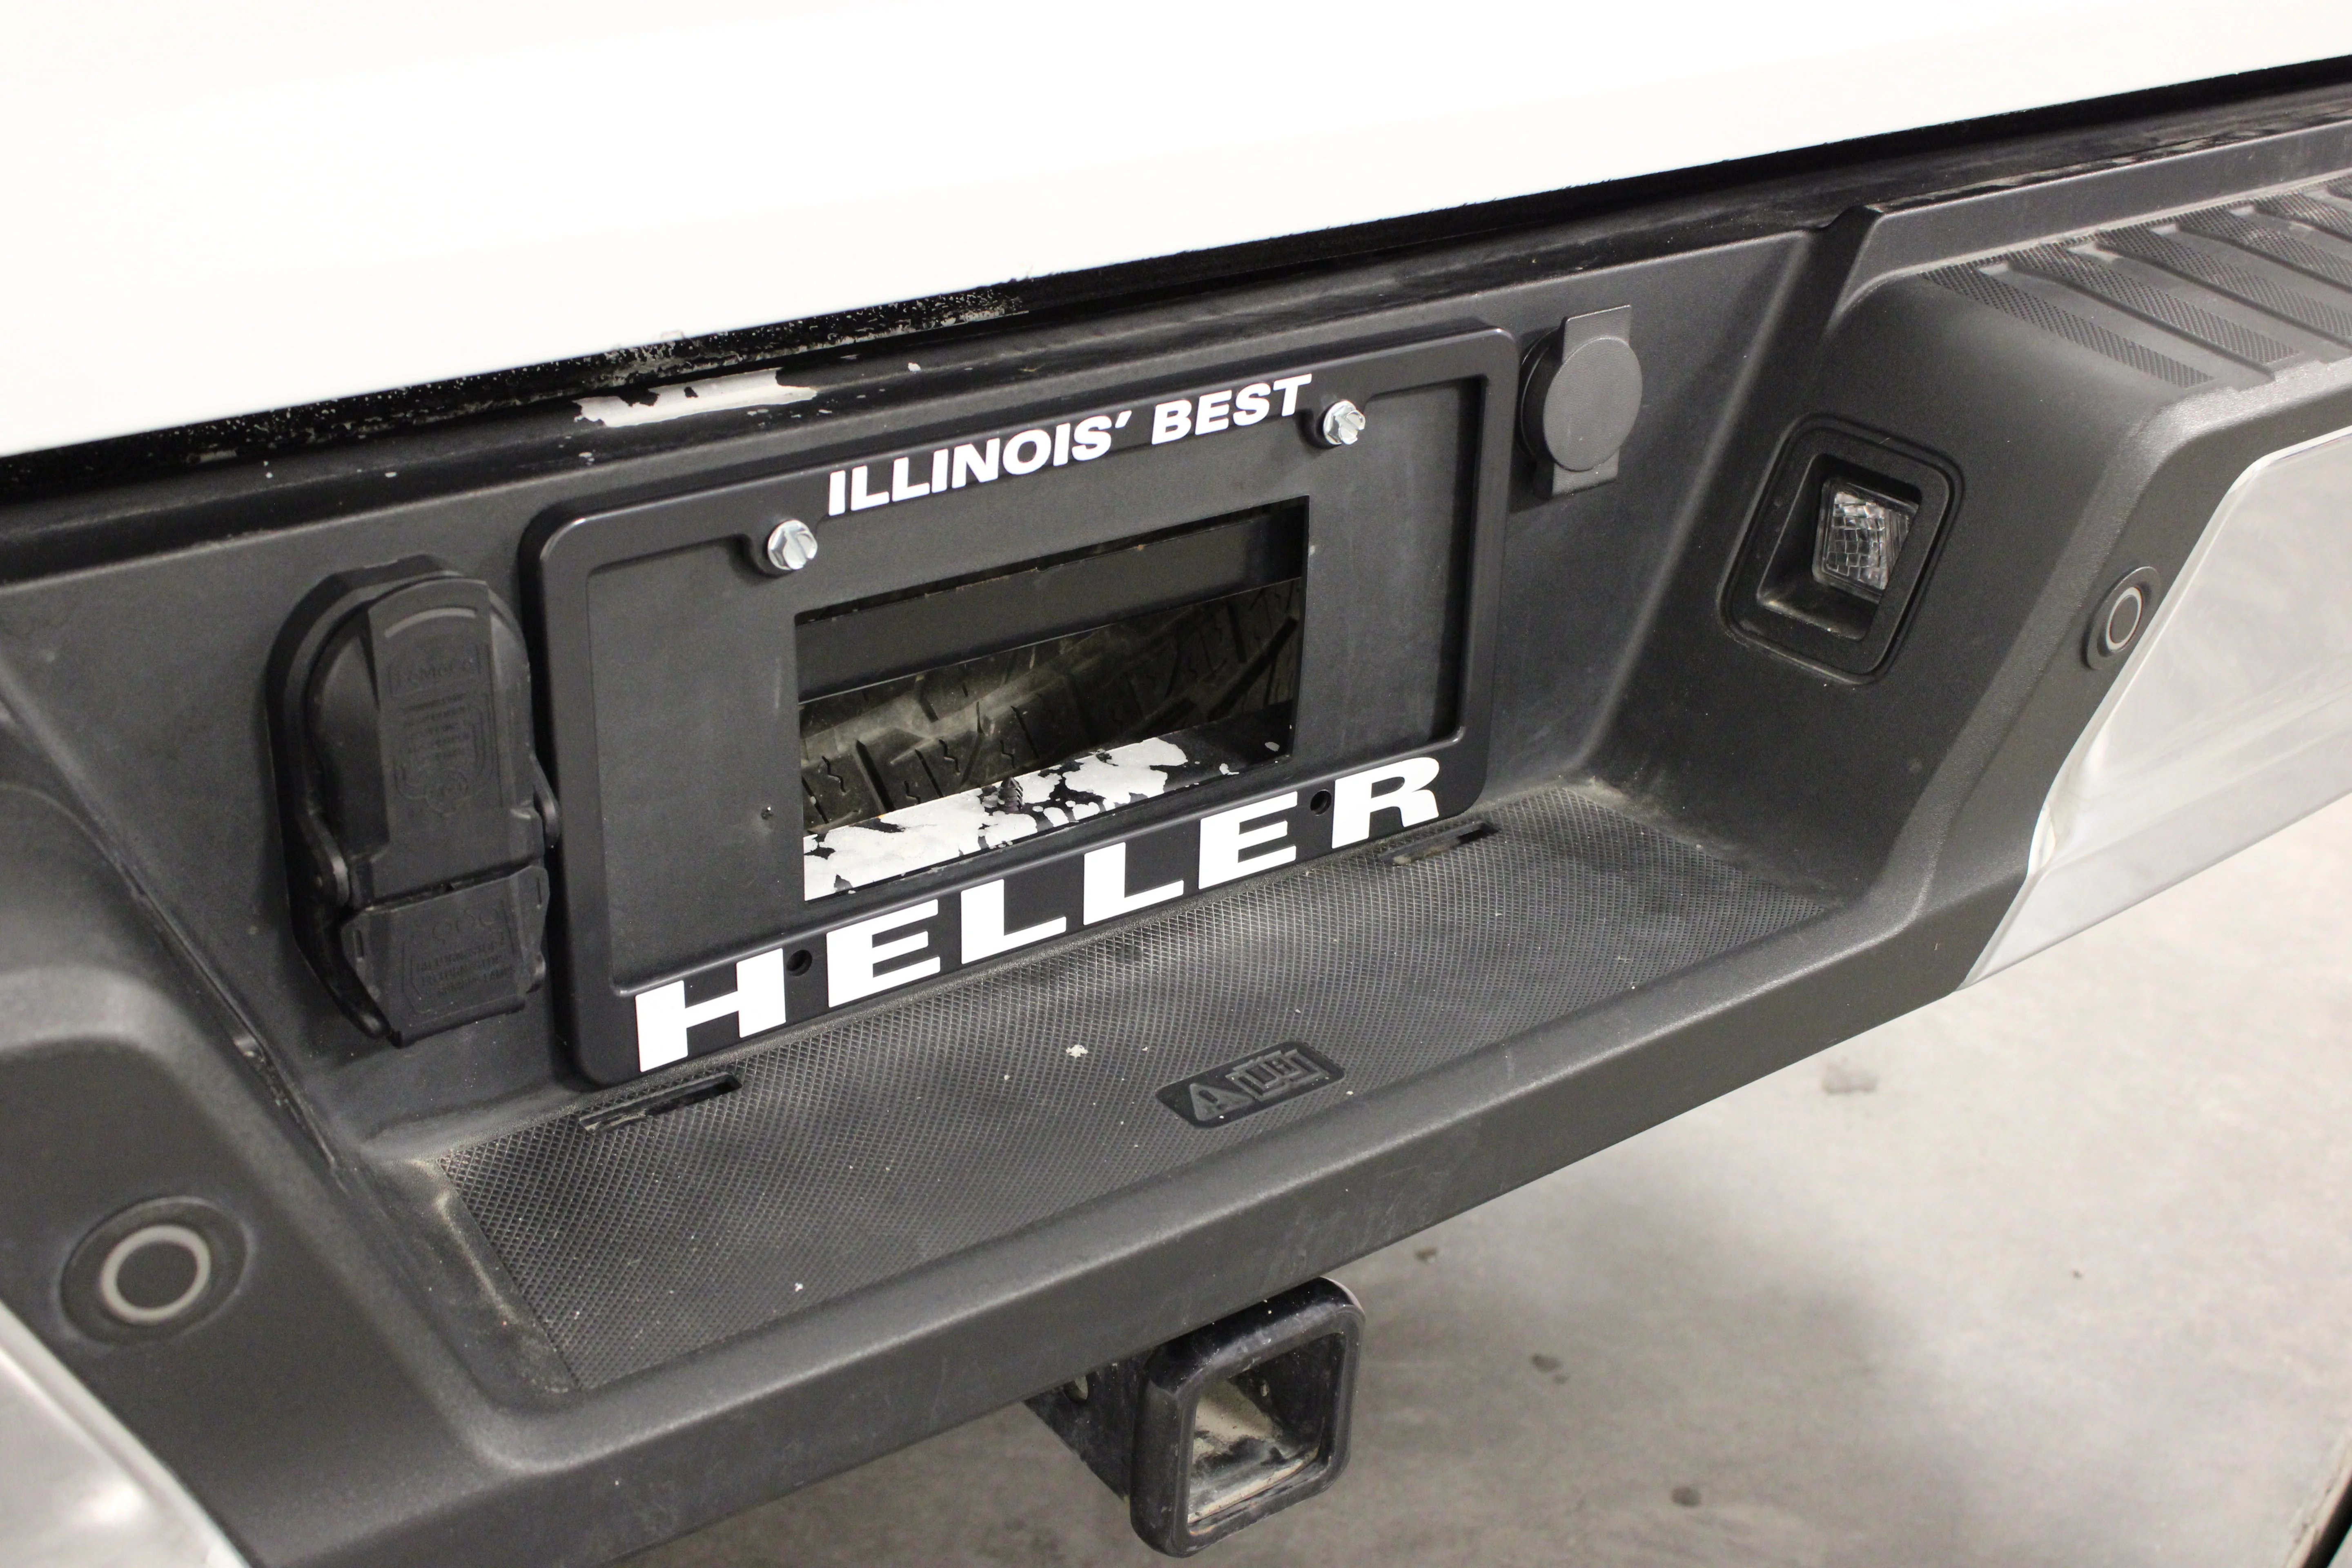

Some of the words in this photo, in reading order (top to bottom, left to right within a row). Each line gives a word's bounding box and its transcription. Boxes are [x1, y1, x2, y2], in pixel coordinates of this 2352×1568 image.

[828, 410, 1132, 516] ILLINOIS'
[1151, 373, 1313, 445] BEST
[635, 756, 1440, 1073] HELLER
